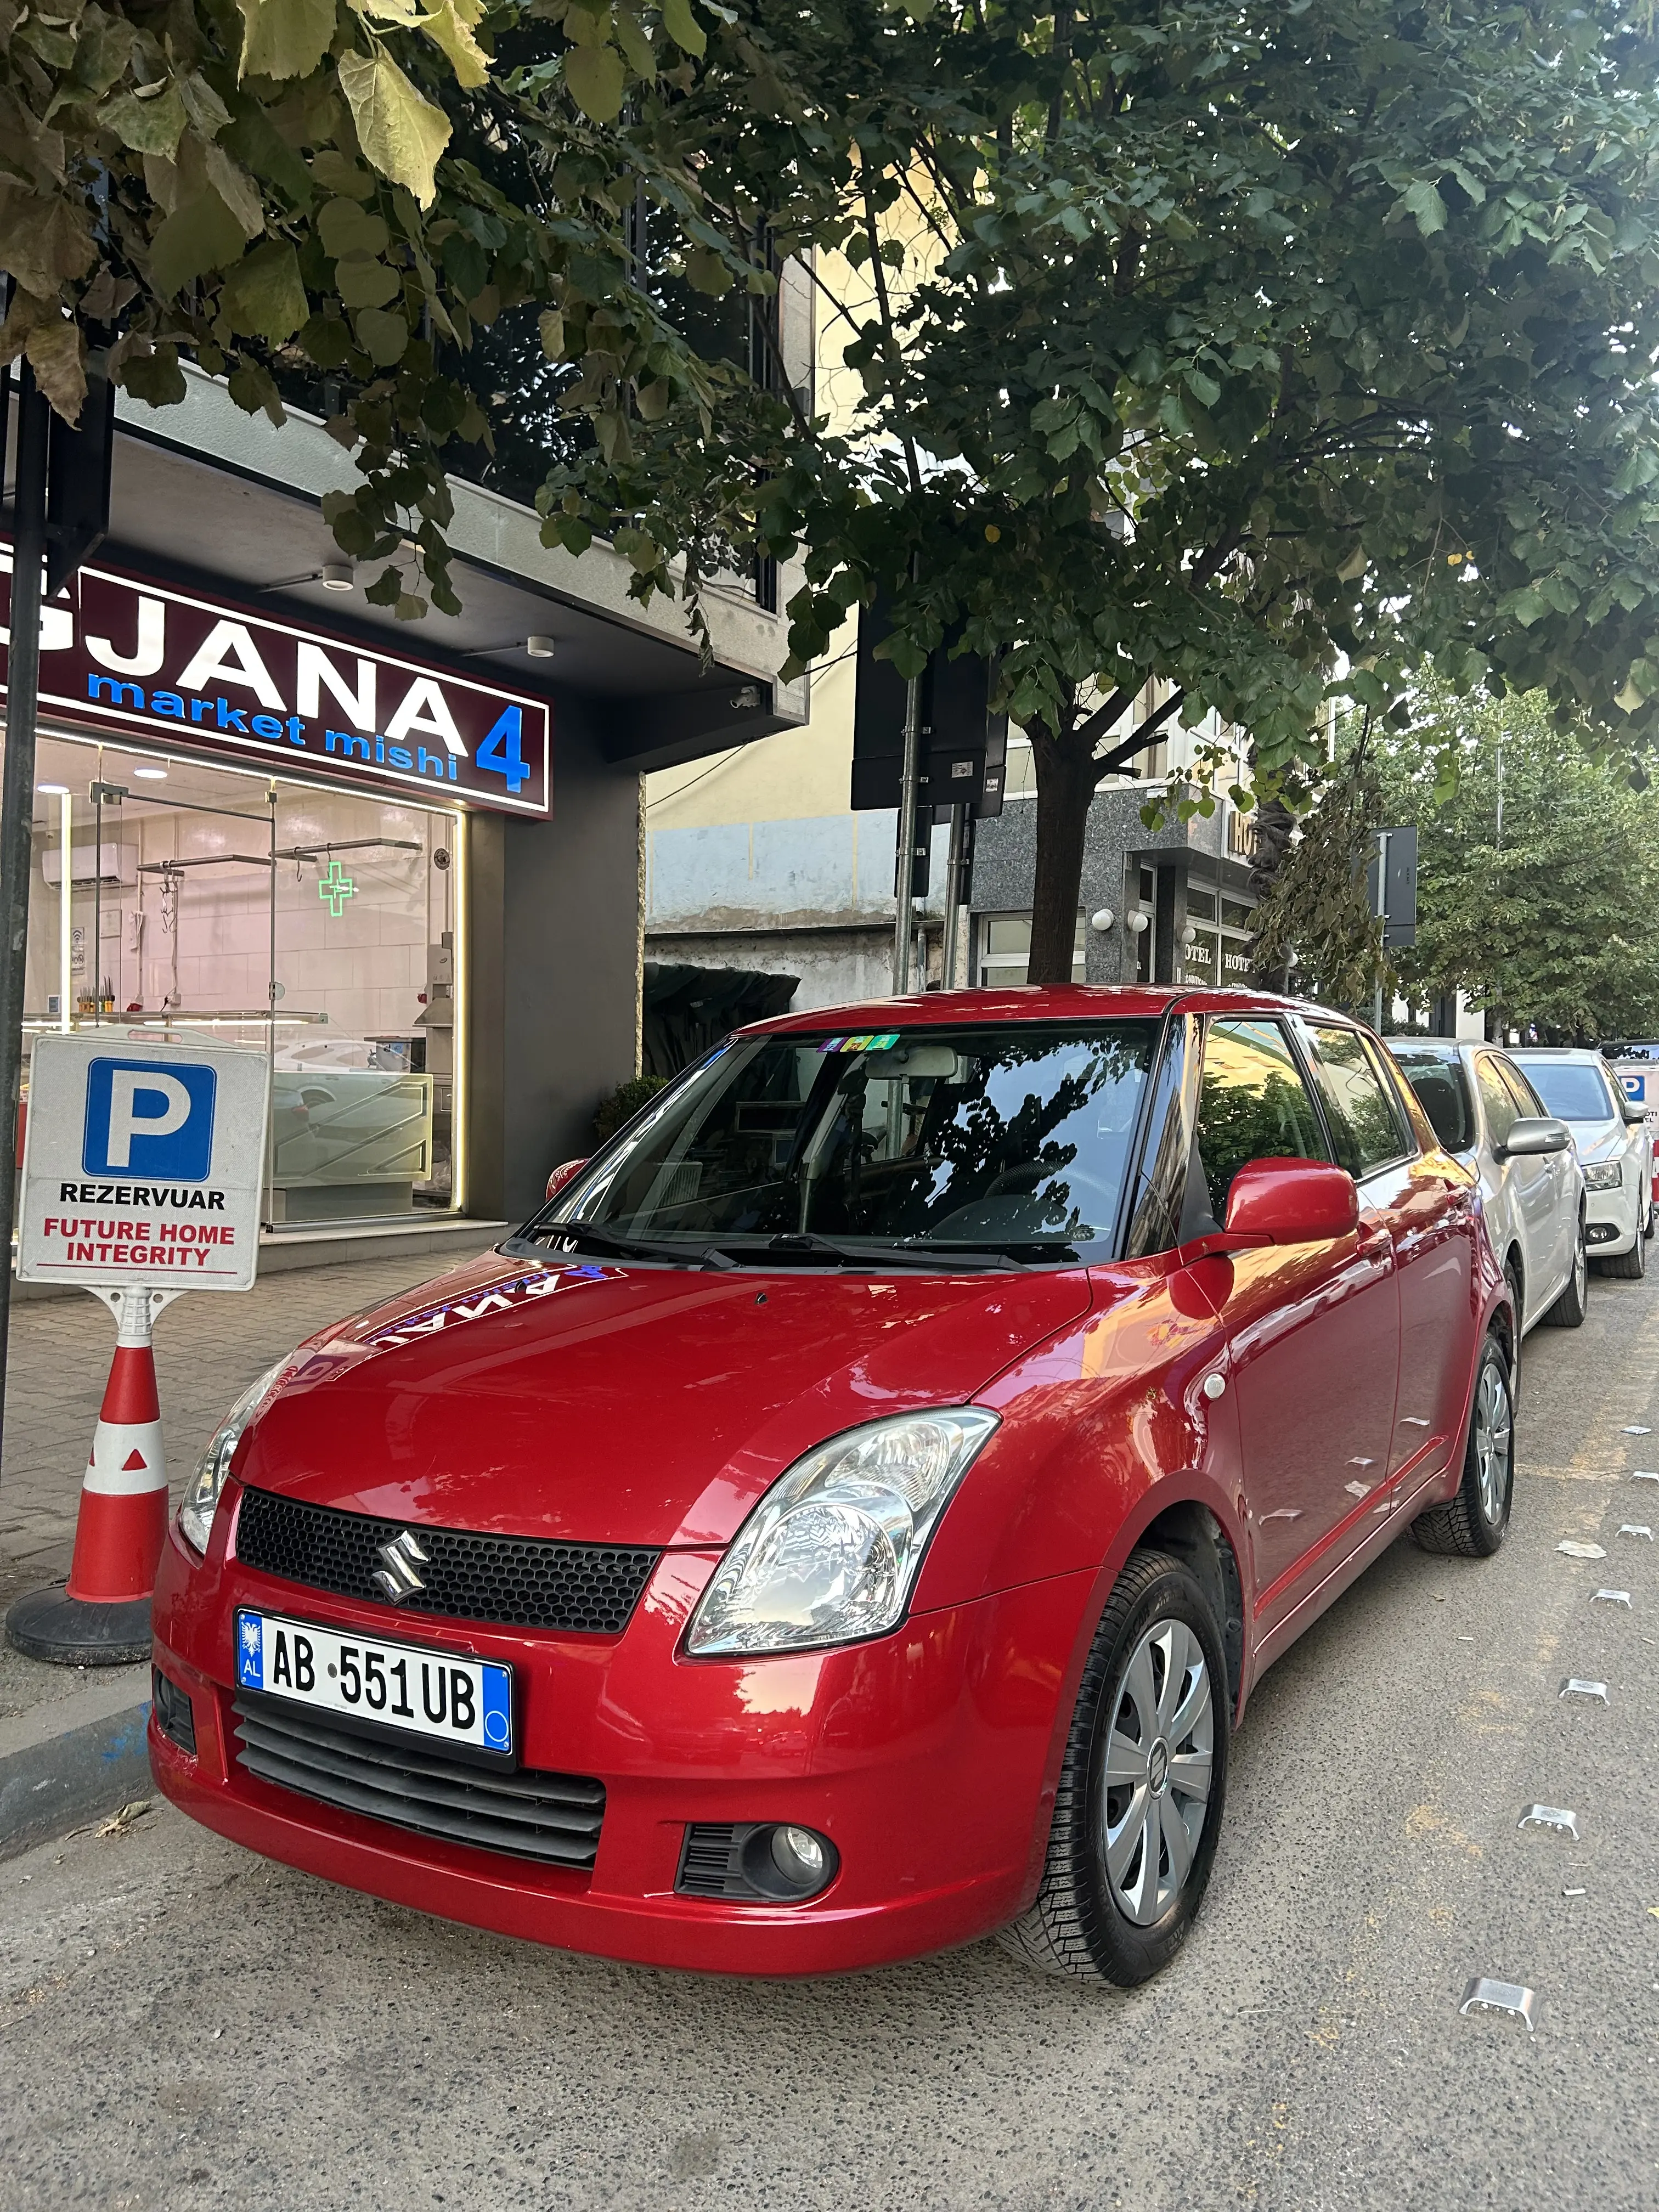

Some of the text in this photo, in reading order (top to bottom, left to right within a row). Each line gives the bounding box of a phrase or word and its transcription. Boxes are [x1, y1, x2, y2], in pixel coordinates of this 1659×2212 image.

[0, 553, 468, 757] JANA
[88, 673, 458, 781] market mishi
[476, 704, 531, 794] 4
[1185, 944, 1211, 964] OTEL
[106, 1069, 191, 1167] P
[60, 1182, 225, 1210] REZERVUAR
[44, 1218, 235, 1245] FUTURE HOME
[67, 1242, 211, 1266] INTEGRITY
[244, 1658, 261, 1678] AL
[273, 1630, 315, 1692] AB
